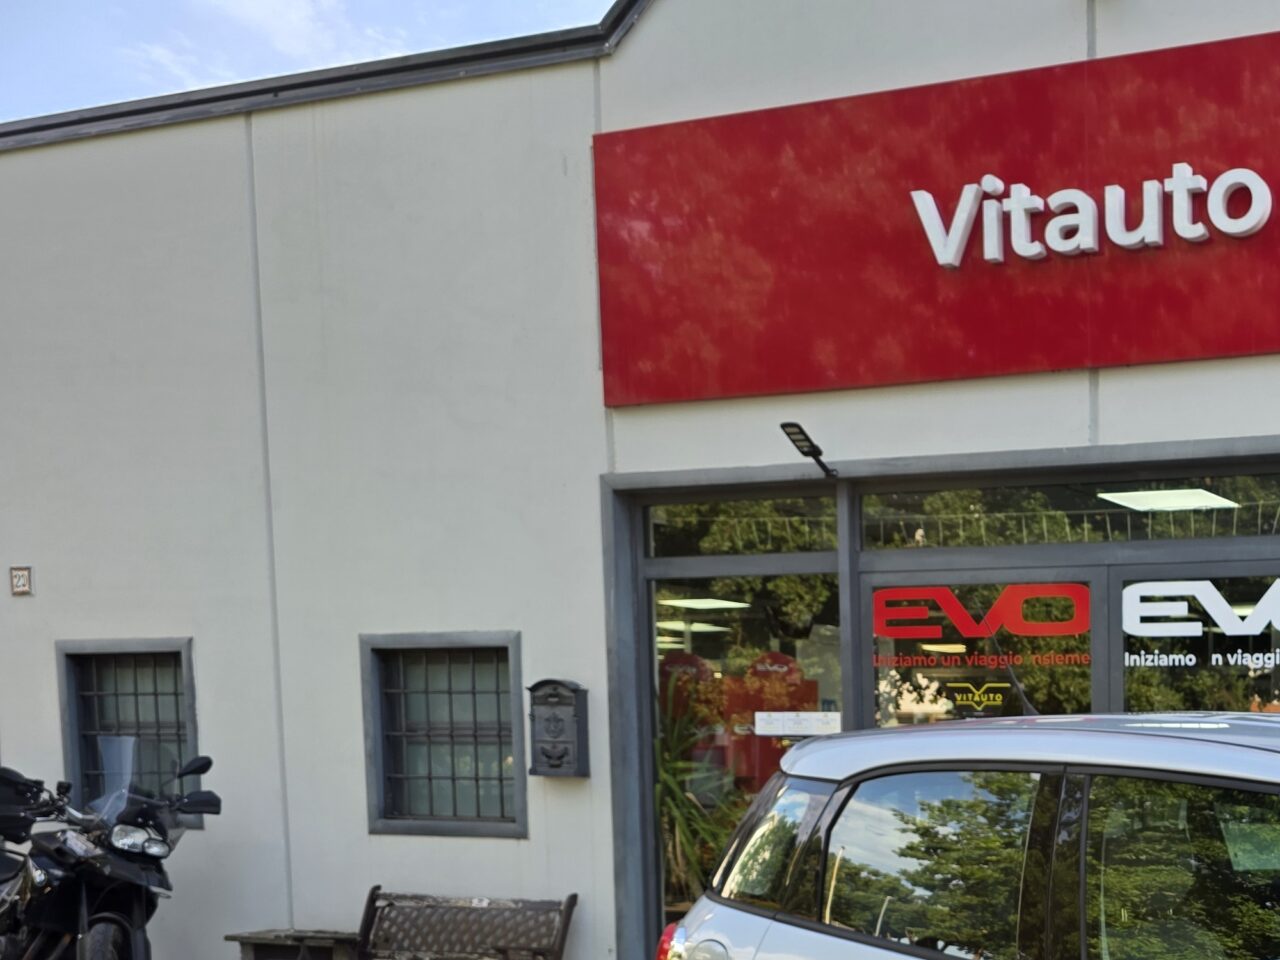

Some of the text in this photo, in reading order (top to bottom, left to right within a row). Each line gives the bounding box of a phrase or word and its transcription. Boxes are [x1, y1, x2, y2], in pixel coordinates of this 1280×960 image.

[910, 162, 1272, 267] Vitauto
[872, 583, 1090, 639] EVO
[941, 655, 961, 667] un
[965, 651, 1023, 669] viaggio
[1124, 649, 1197, 667] Iniziamo
[953, 692, 1003, 702] VITAUTO
